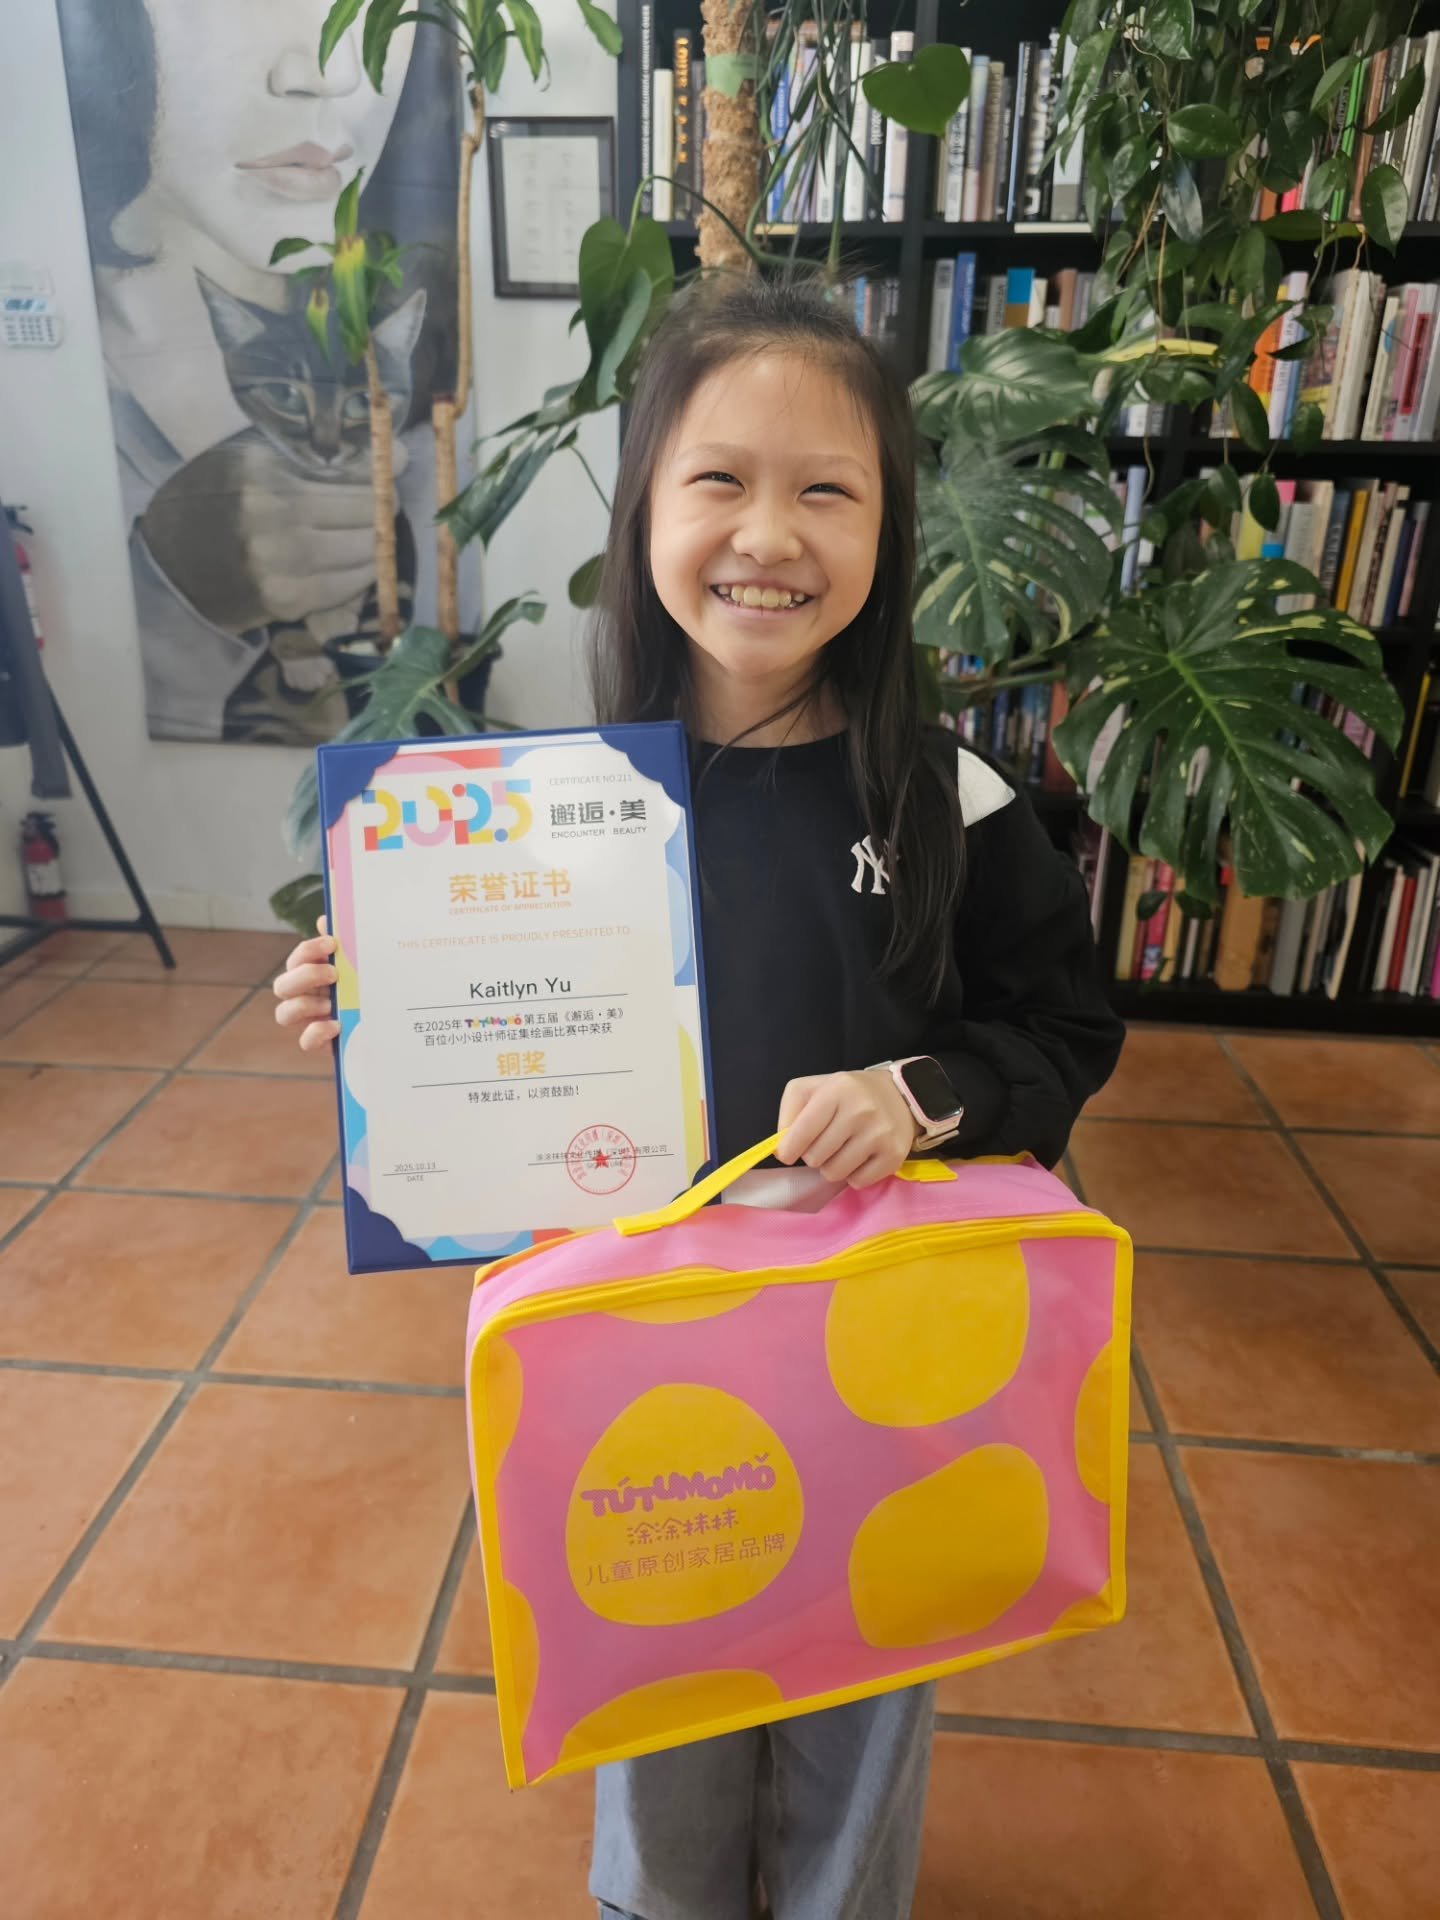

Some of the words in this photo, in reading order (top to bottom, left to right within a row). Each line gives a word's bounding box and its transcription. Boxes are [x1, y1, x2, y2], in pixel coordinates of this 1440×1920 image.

[549, 775, 601, 786] CERTIFICATE
[362, 779, 533, 851] 2025
[551, 828, 605, 839] ENCOUNTER
[613, 826, 647, 836] BEAUTY
[850, 834, 890, 895] NY
[448, 868, 572, 903] 荣誉证书
[397, 940, 420, 950] THIS
[422, 935, 487, 949] CERTIFICATE
[490, 935, 499, 944] IS
[502, 931, 549, 943] PROUDLY
[552, 927, 613, 940] PRESENTED
[616, 926, 630, 936] TO
[470, 979, 538, 1000] Kaitlyn
[545, 977, 571, 994] Yu
[413, 1019, 462, 1033] 在2025年
[424, 1022, 613, 1046] 百位小小设计师征集绘画比赛中荣获
[496, 1050, 546, 1077] 铜奖
[407, 1174, 424, 1183] DATE
[627, 1508, 739, 1546] 涂涂抹抹
[585, 1533, 785, 1586] 儿童原创家居品牌
